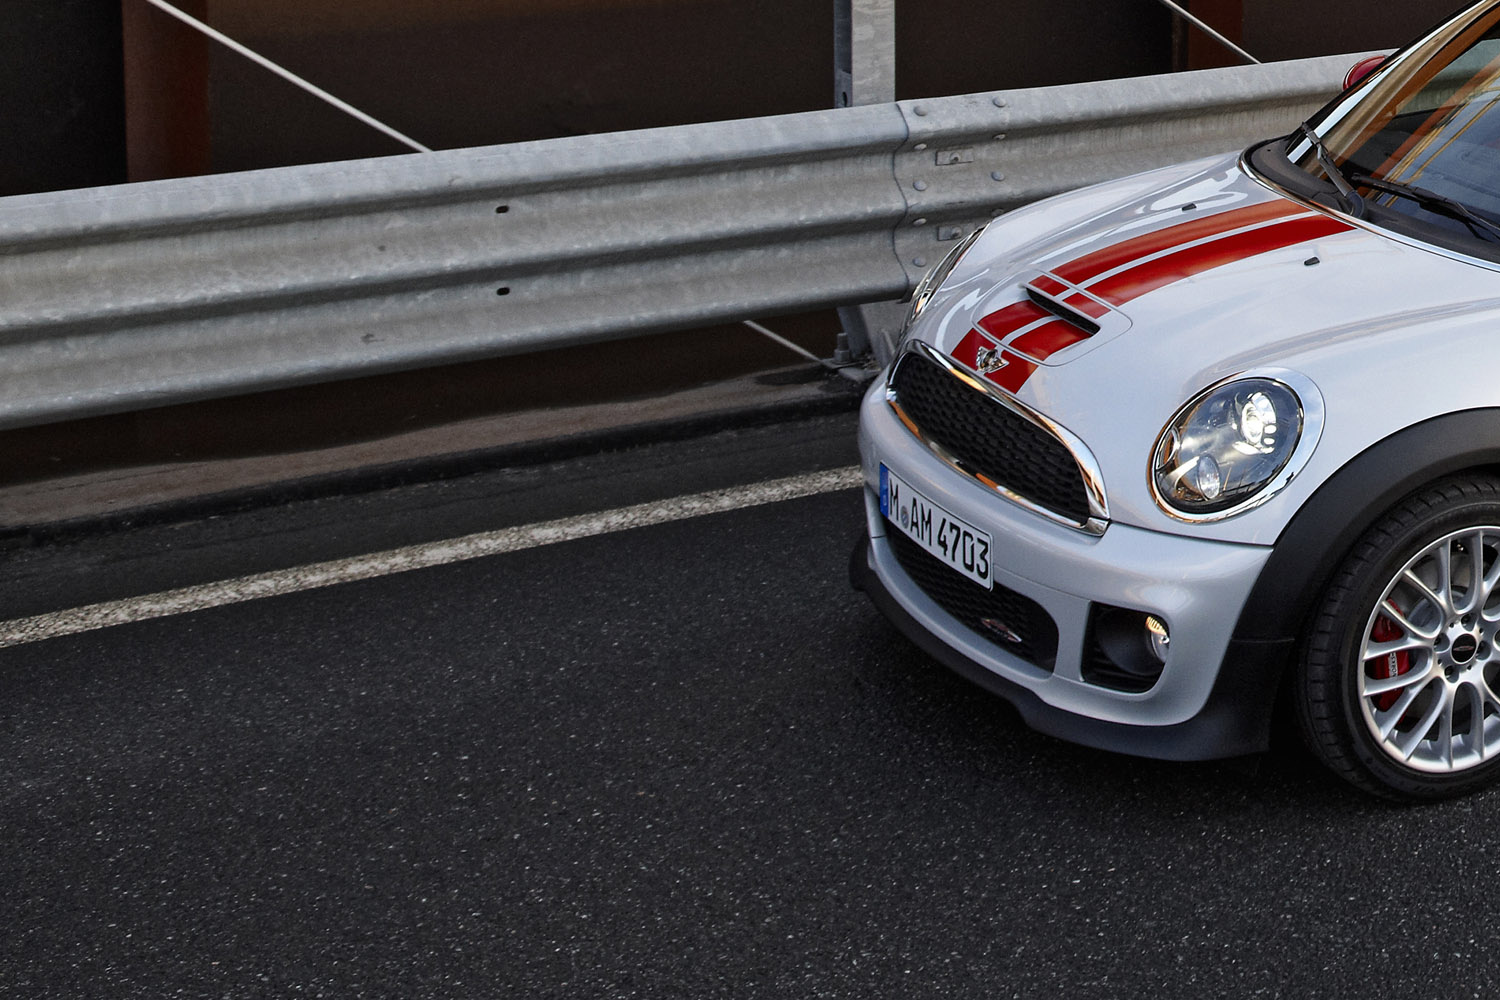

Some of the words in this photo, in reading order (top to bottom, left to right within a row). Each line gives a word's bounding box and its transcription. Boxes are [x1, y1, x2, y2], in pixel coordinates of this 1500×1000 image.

[889, 478, 899, 522] M
[910, 497, 932, 547] AM
[937, 518, 989, 580] 4703
